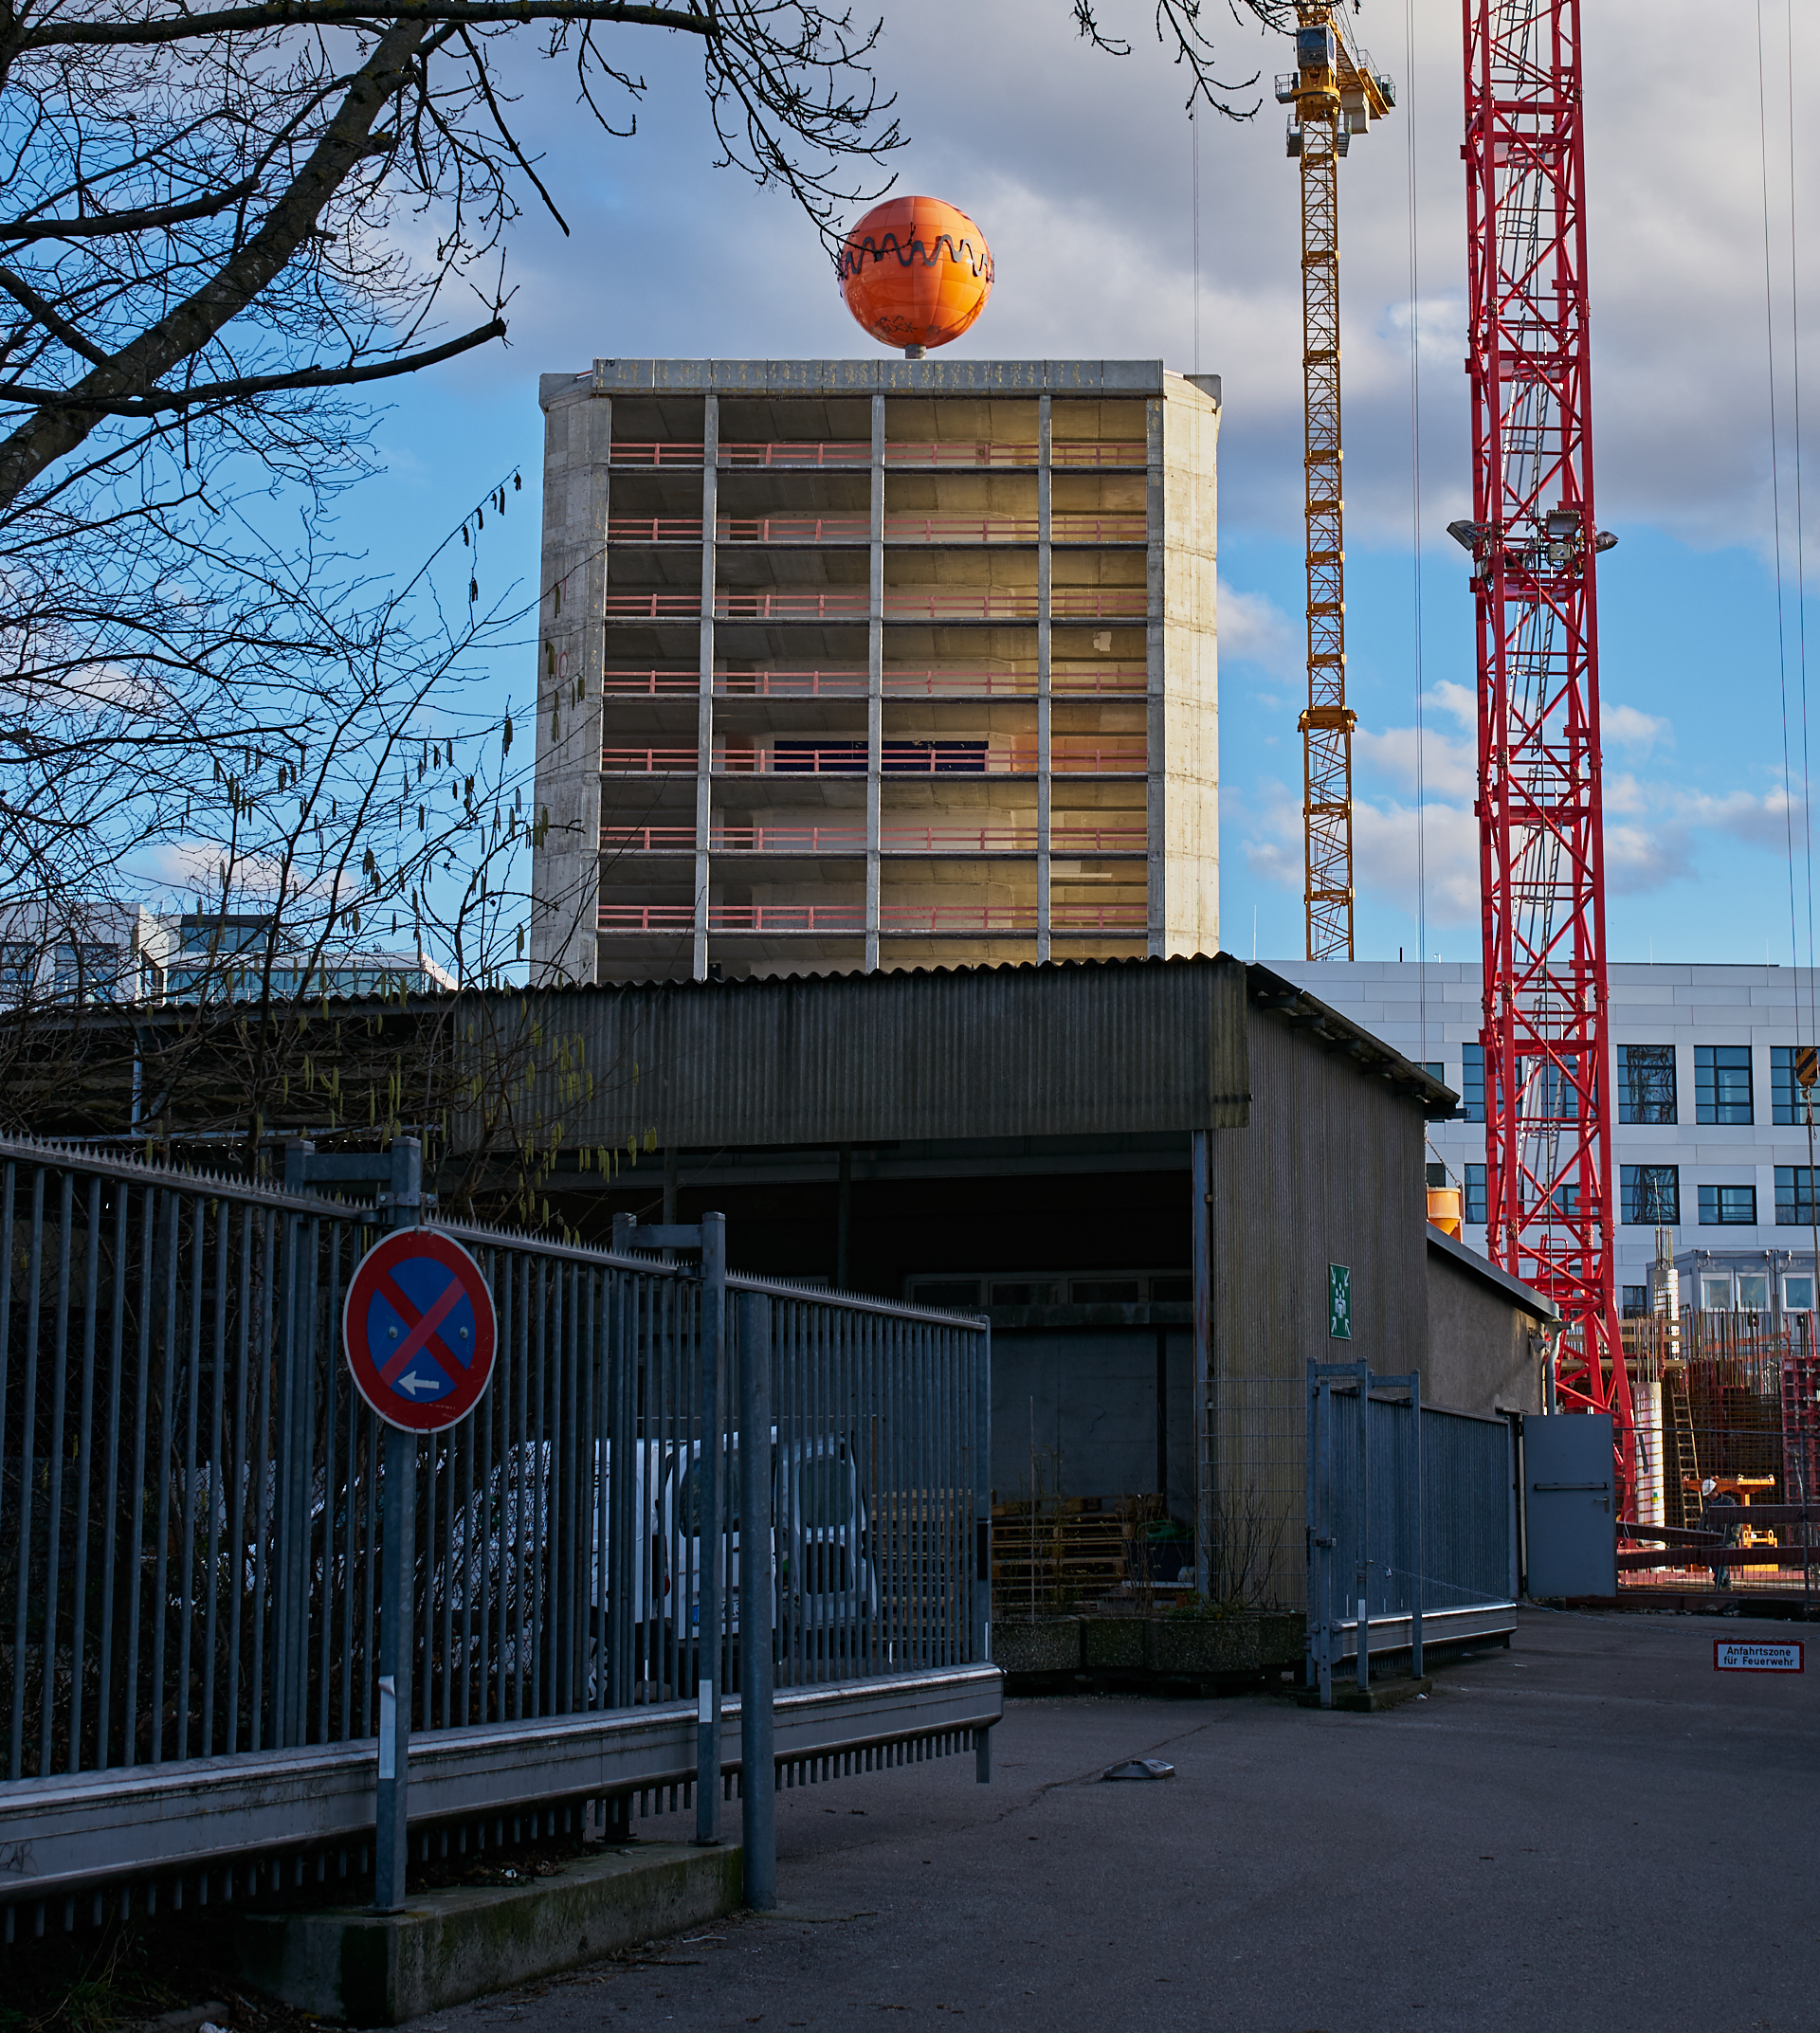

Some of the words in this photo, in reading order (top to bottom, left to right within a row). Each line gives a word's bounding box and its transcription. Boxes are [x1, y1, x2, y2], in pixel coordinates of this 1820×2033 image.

[1727, 1646, 1791, 1656] Anfahrtszone
[1723, 1656, 1738, 1664] für
[1742, 1656, 1793, 1665] Feuerwehr
